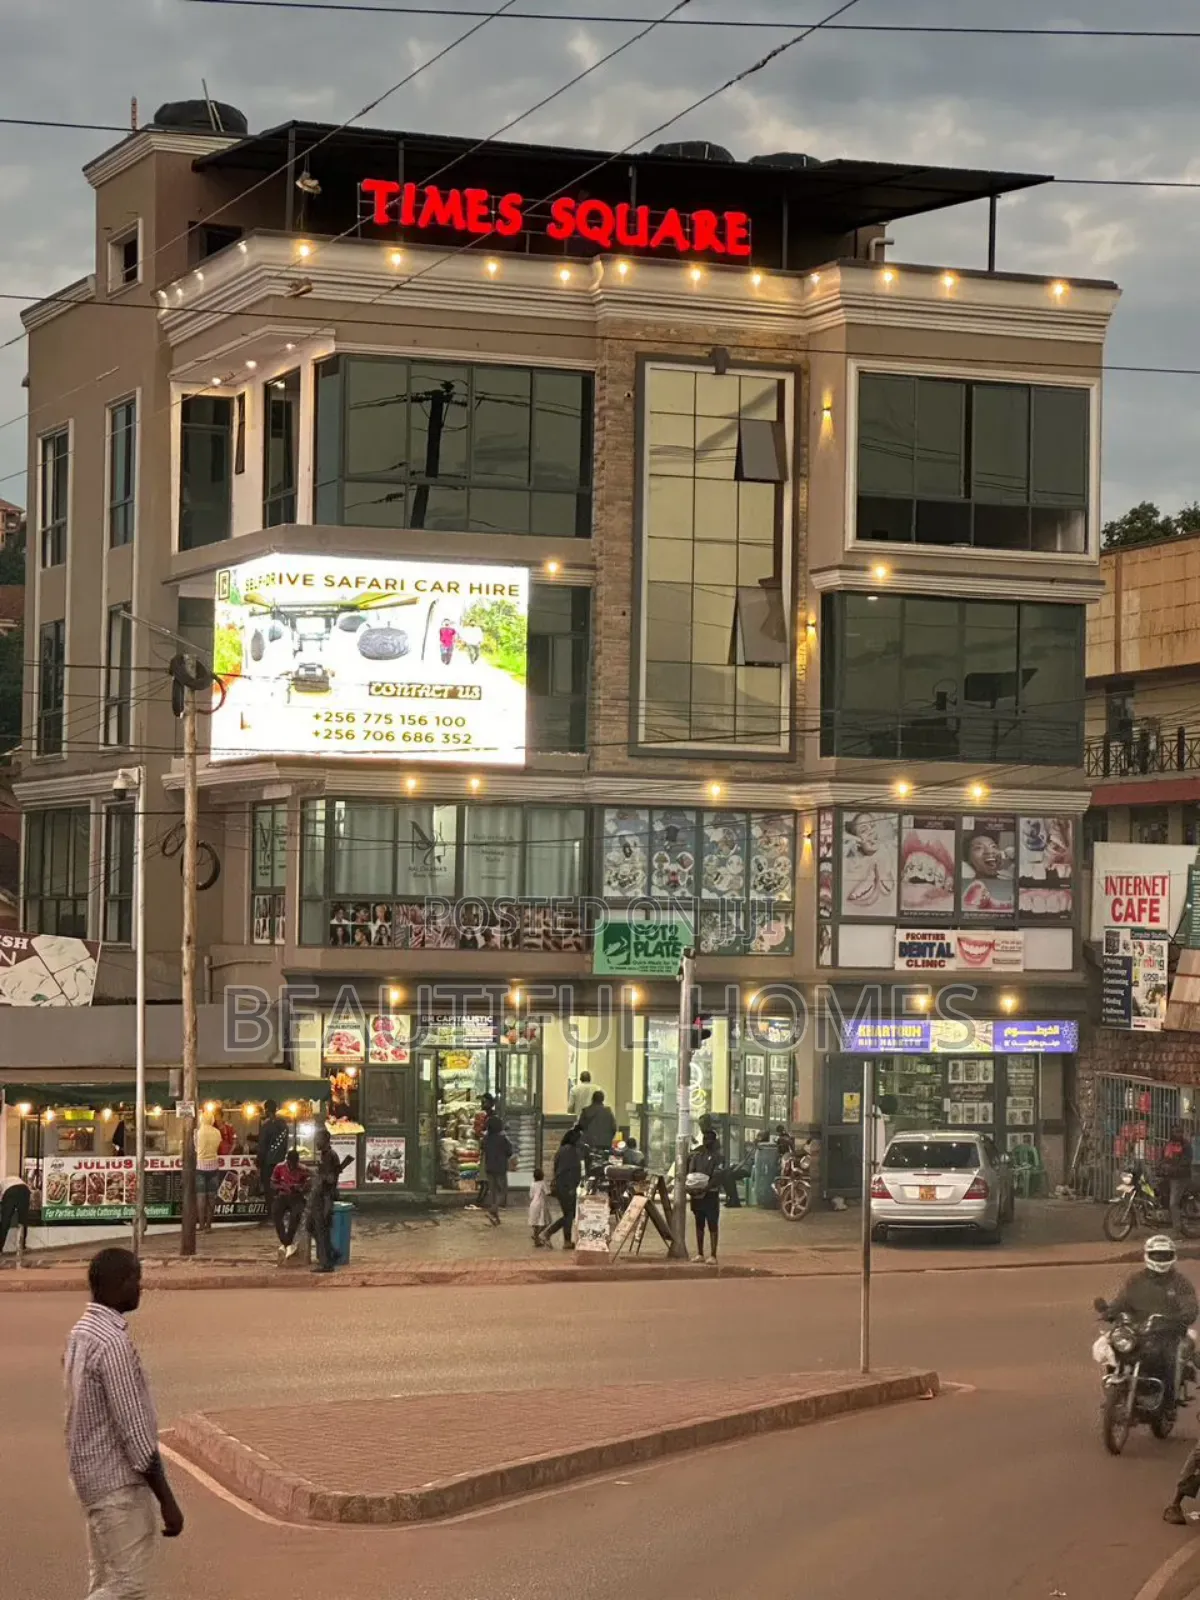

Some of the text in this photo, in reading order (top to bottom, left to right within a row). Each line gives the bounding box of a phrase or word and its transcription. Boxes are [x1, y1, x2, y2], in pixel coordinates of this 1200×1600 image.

[361, 178, 751, 256] TIMES SQUARE
[324, 575, 405, 591] SAFARI
[415, 579, 460, 594] CAR
[469, 583, 521, 597] HIRE
[313, 711, 466, 728] +256 775 156 100
[312, 728, 472, 745] +256 706 686 352
[1105, 875, 1168, 896] INTERNET
[1111, 898, 1160, 922] CAFE
[905, 932, 946, 941] FRONTIER
[633, 940, 682, 958] PLATE
[898, 941, 955, 958] DENTAL
[905, 959, 946, 968] CLINIC
[436, 1015, 494, 1023] CAPITALISTIC
[73, 1158, 134, 1170] JULIUS
